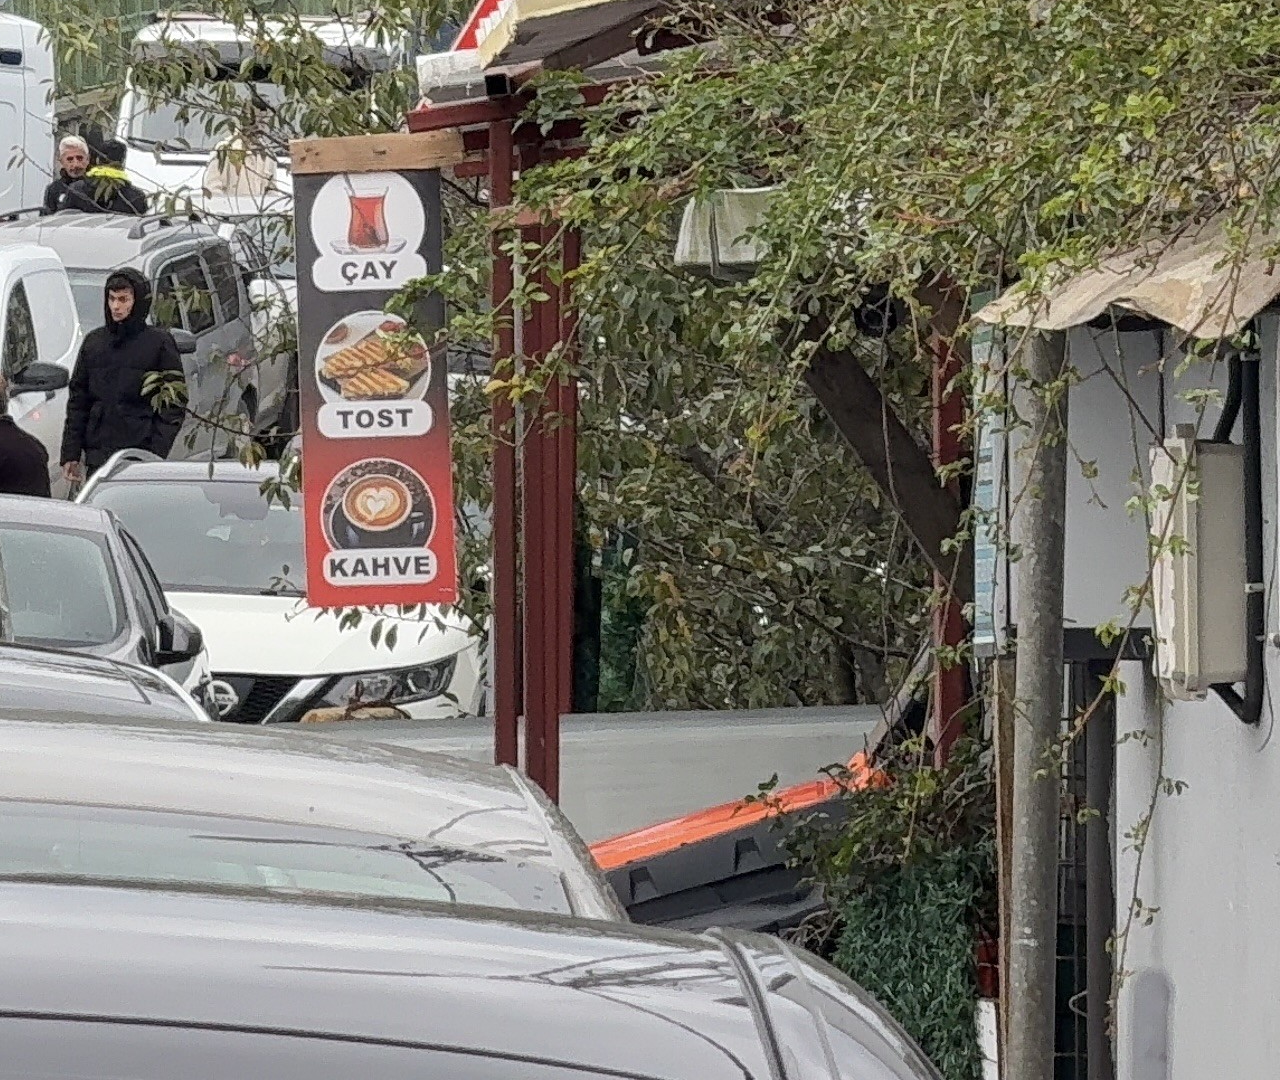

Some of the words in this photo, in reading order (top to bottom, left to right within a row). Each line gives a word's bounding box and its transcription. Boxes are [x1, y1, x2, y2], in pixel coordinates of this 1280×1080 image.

[341, 260, 398, 286] ÇAY
[336, 408, 413, 429] TOST
[329, 556, 431, 577] KAHVE
